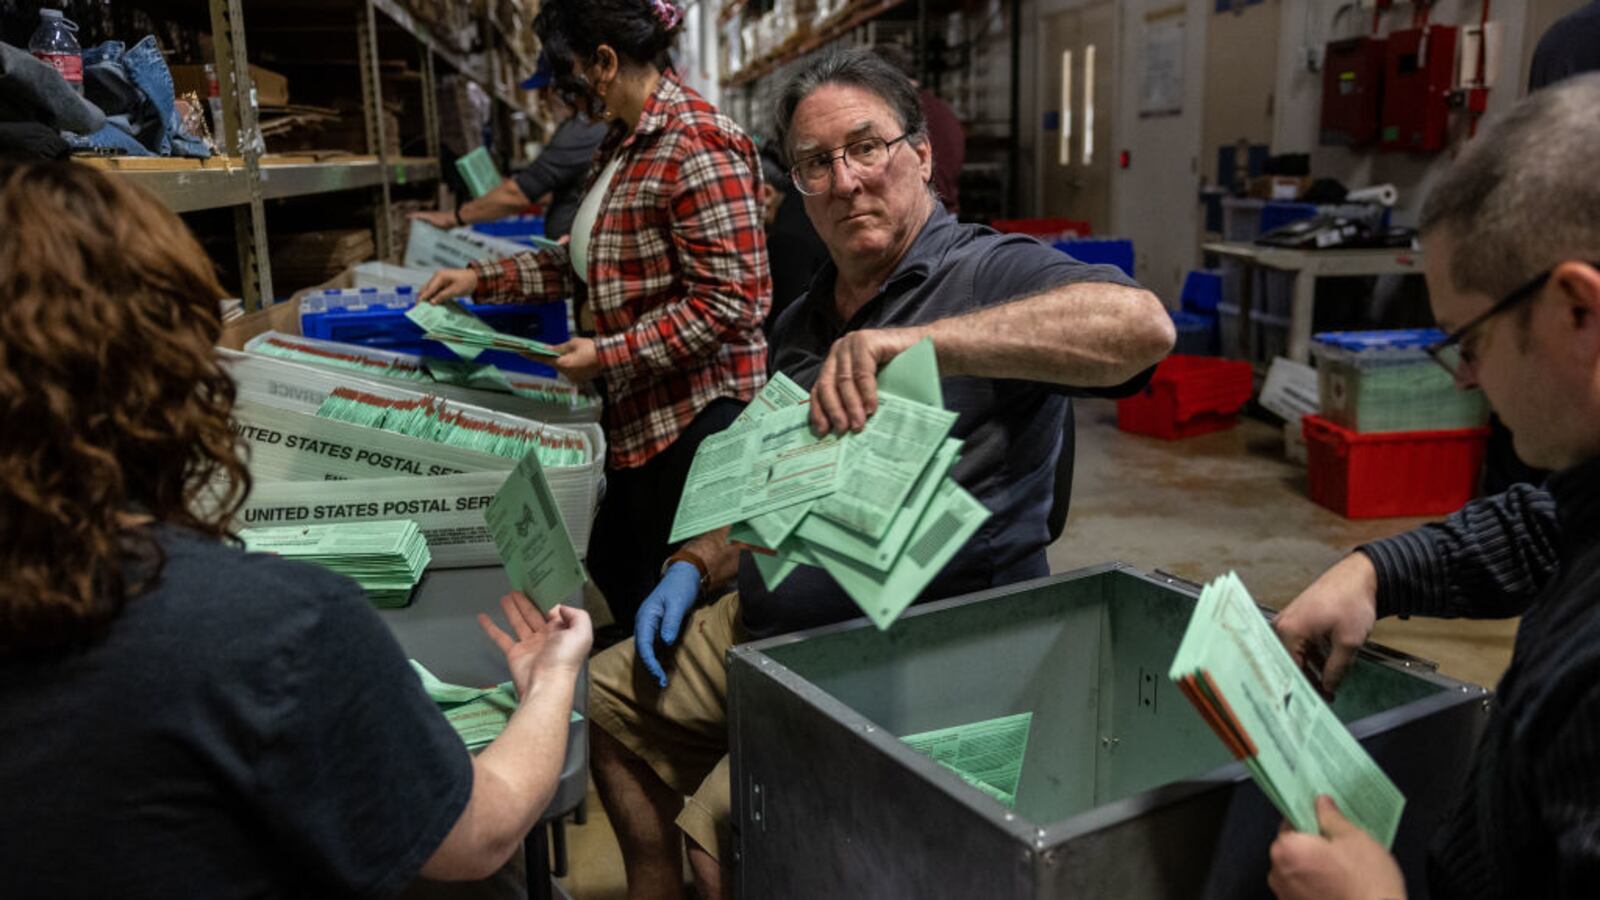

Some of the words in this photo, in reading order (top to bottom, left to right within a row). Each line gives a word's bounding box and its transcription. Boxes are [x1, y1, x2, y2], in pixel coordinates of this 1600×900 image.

[285, 435, 353, 460] STATES
[355, 449, 423, 476] POSTAL
[244, 506, 309, 523] UNITED
[313, 502, 378, 519] STATES
[383, 499, 450, 515] POSTAL
